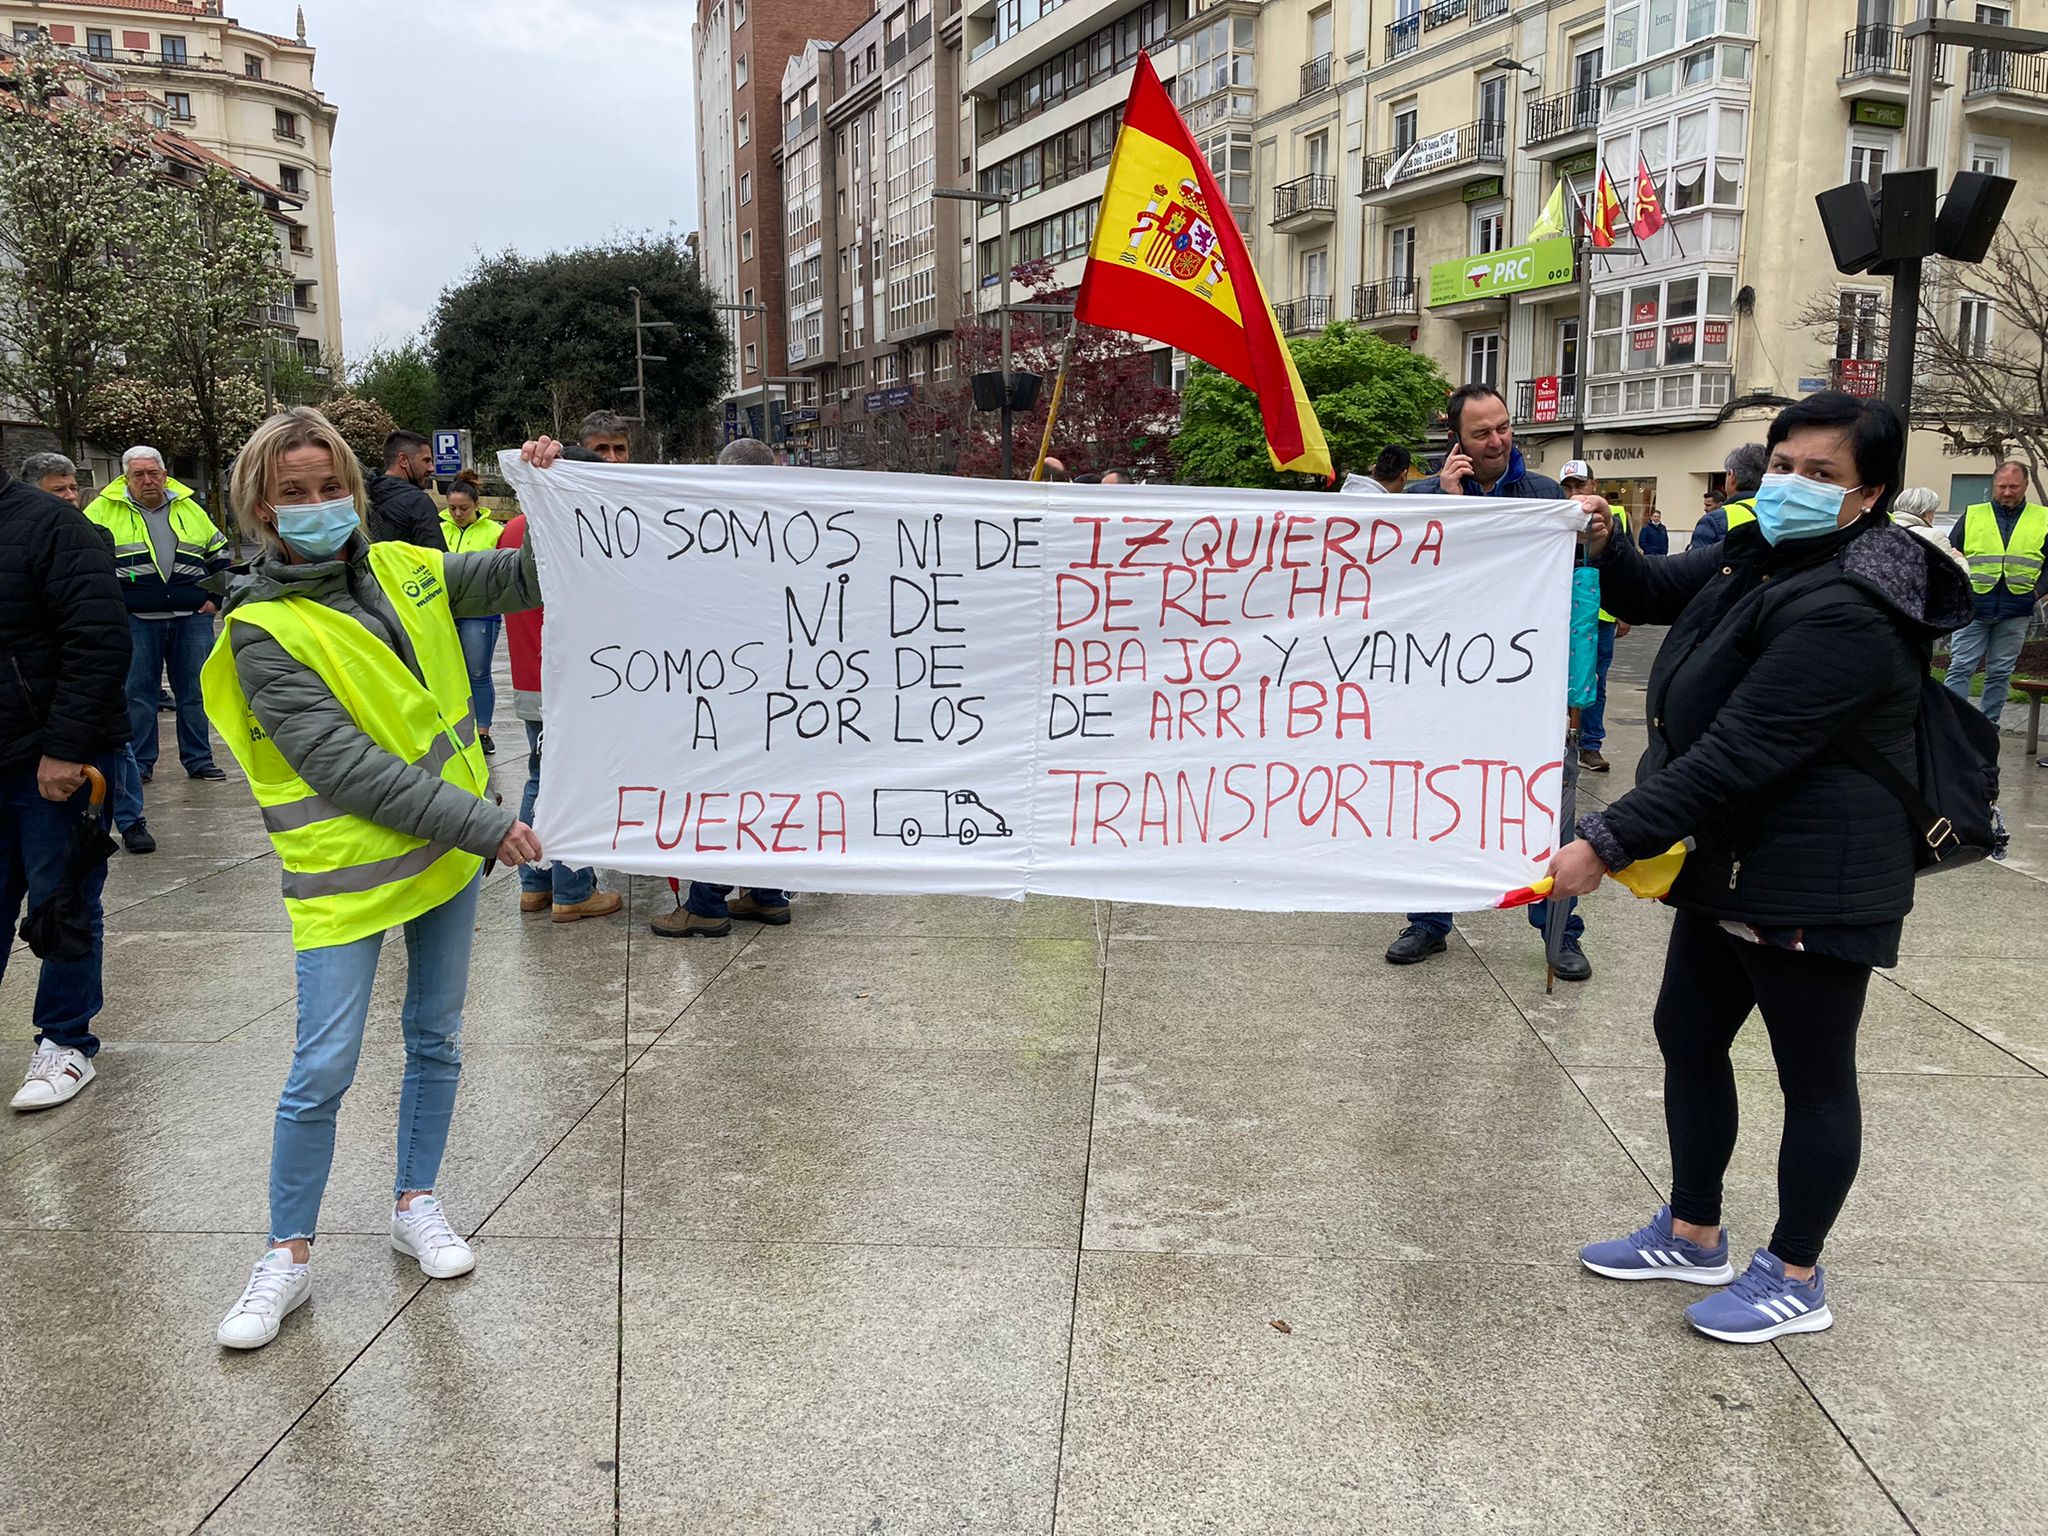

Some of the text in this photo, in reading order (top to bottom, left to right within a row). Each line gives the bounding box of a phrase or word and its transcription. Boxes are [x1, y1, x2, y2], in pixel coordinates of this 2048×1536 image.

[1655, 13, 1673, 26] bmc
[1877, 109, 1897, 121] PRC
[1573, 155, 1592, 170] PRC
[1478, 183, 1493, 195] PRC
[1493, 257, 1531, 285] PRC
[1635, 331, 1654, 340] VENTA
[1672, 325, 1693, 335] VENTA
[1705, 324, 1725, 333] VENTA
[1537, 400, 1556, 410] VENTA
[438, 434, 455, 454] P
[575, 505, 641, 559] NO
[664, 507, 861, 568] SOMOS
[975, 516, 1043, 570] DE
[889, 573, 967, 639] DE
[1055, 563, 1372, 633] DERECHA
[589, 628, 1539, 699] SOMOS LOS DE ABAJO Y VAMOS
[692, 695, 719, 752] A
[766, 691, 872, 752] POR
[893, 694, 986, 746] LOS
[1048, 692, 1115, 741] DE
[612, 758, 1564, 864] FUERZA TRANSPORTISTAS
